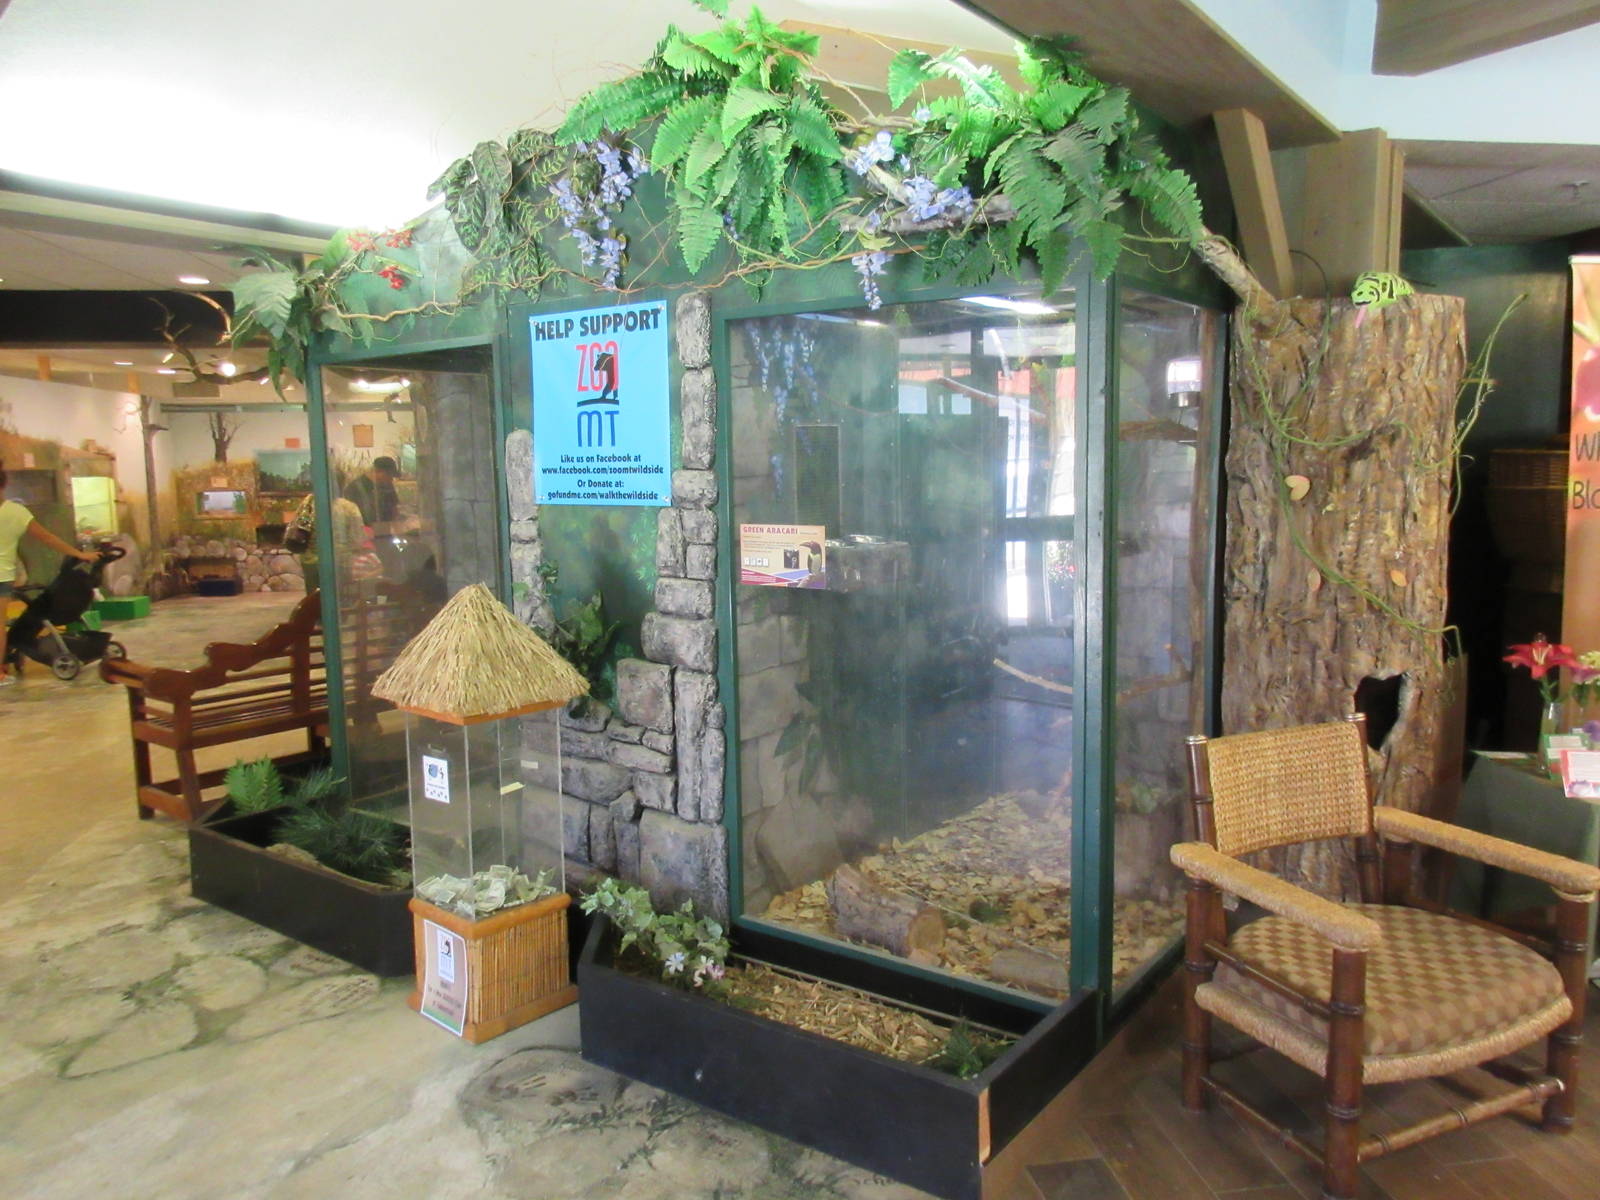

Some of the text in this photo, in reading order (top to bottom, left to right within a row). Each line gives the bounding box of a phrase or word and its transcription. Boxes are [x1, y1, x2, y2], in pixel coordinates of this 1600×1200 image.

[535, 307, 661, 341] HELP SUPPORT
[560, 454, 575, 463] Like
[585, 455, 595, 463] on
[596, 453, 632, 463] Facebook
[633, 454, 641, 462] at
[577, 479, 625, 488] Or Donate at:
